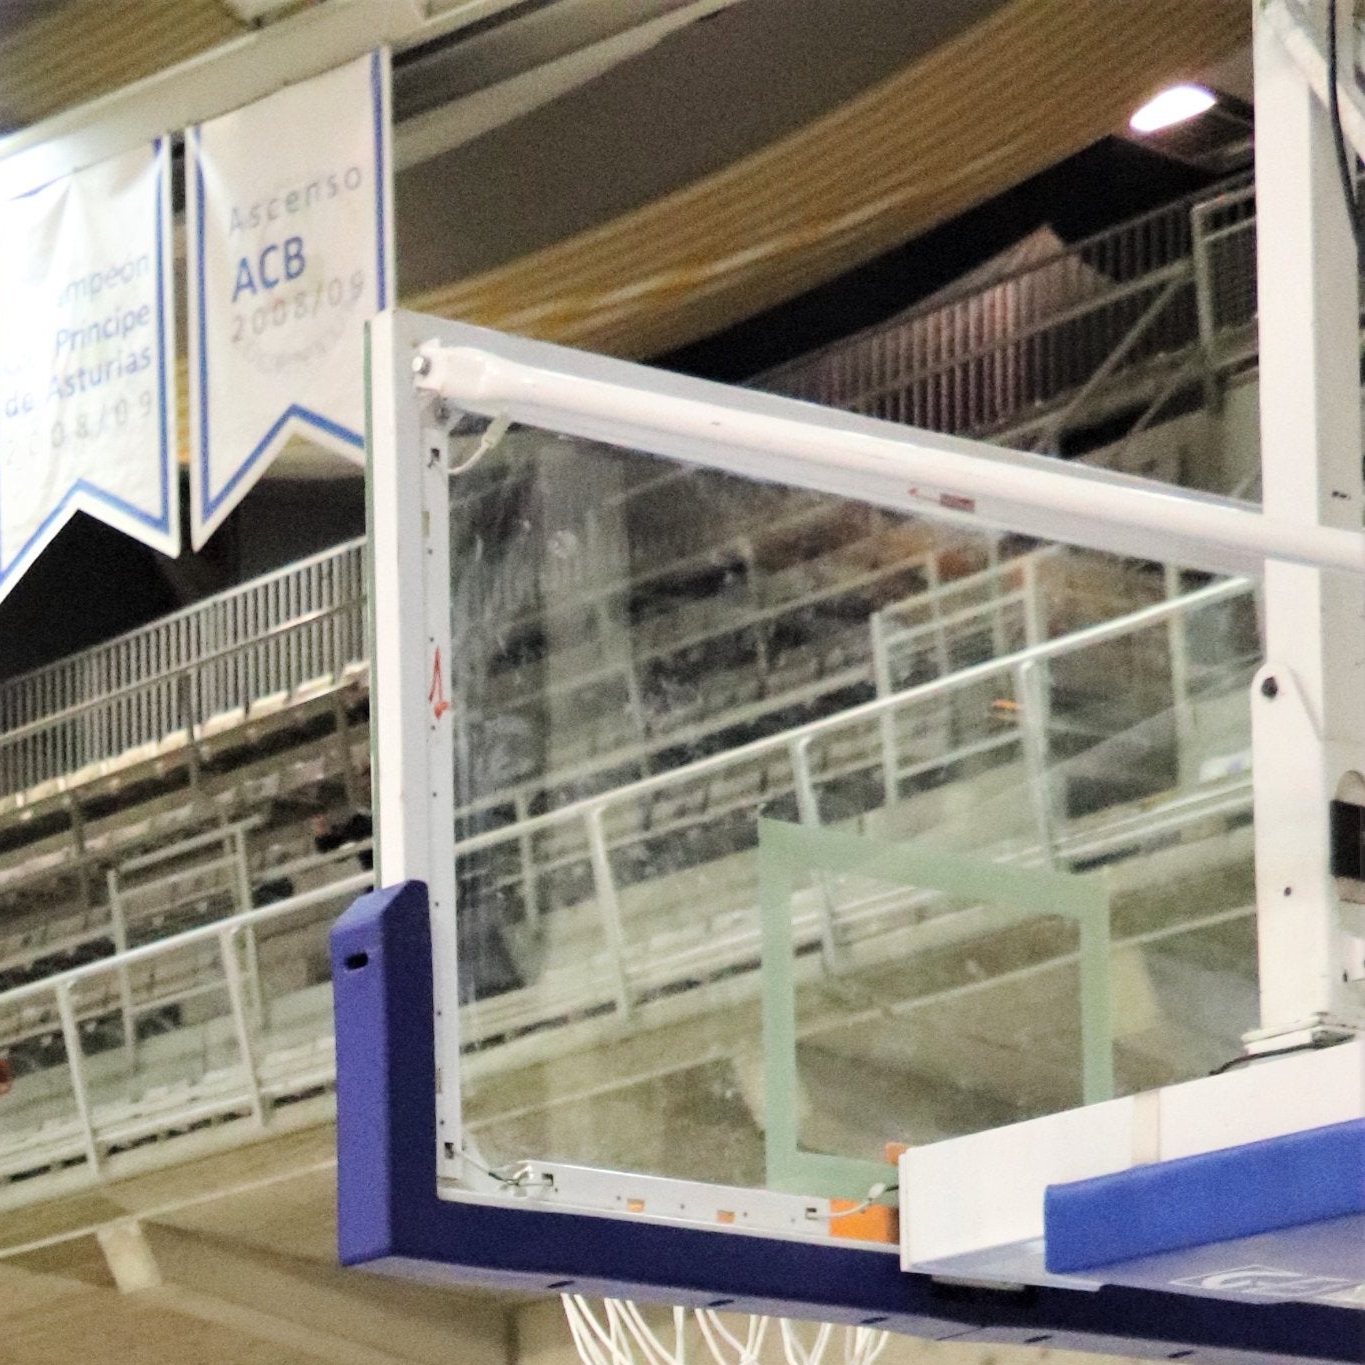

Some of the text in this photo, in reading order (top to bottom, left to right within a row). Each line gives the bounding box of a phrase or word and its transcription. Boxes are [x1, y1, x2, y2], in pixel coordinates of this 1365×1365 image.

[230, 166, 362, 233] Ascenso
[231, 236, 307, 303] ACB
[46, 345, 153, 402] Asturias
